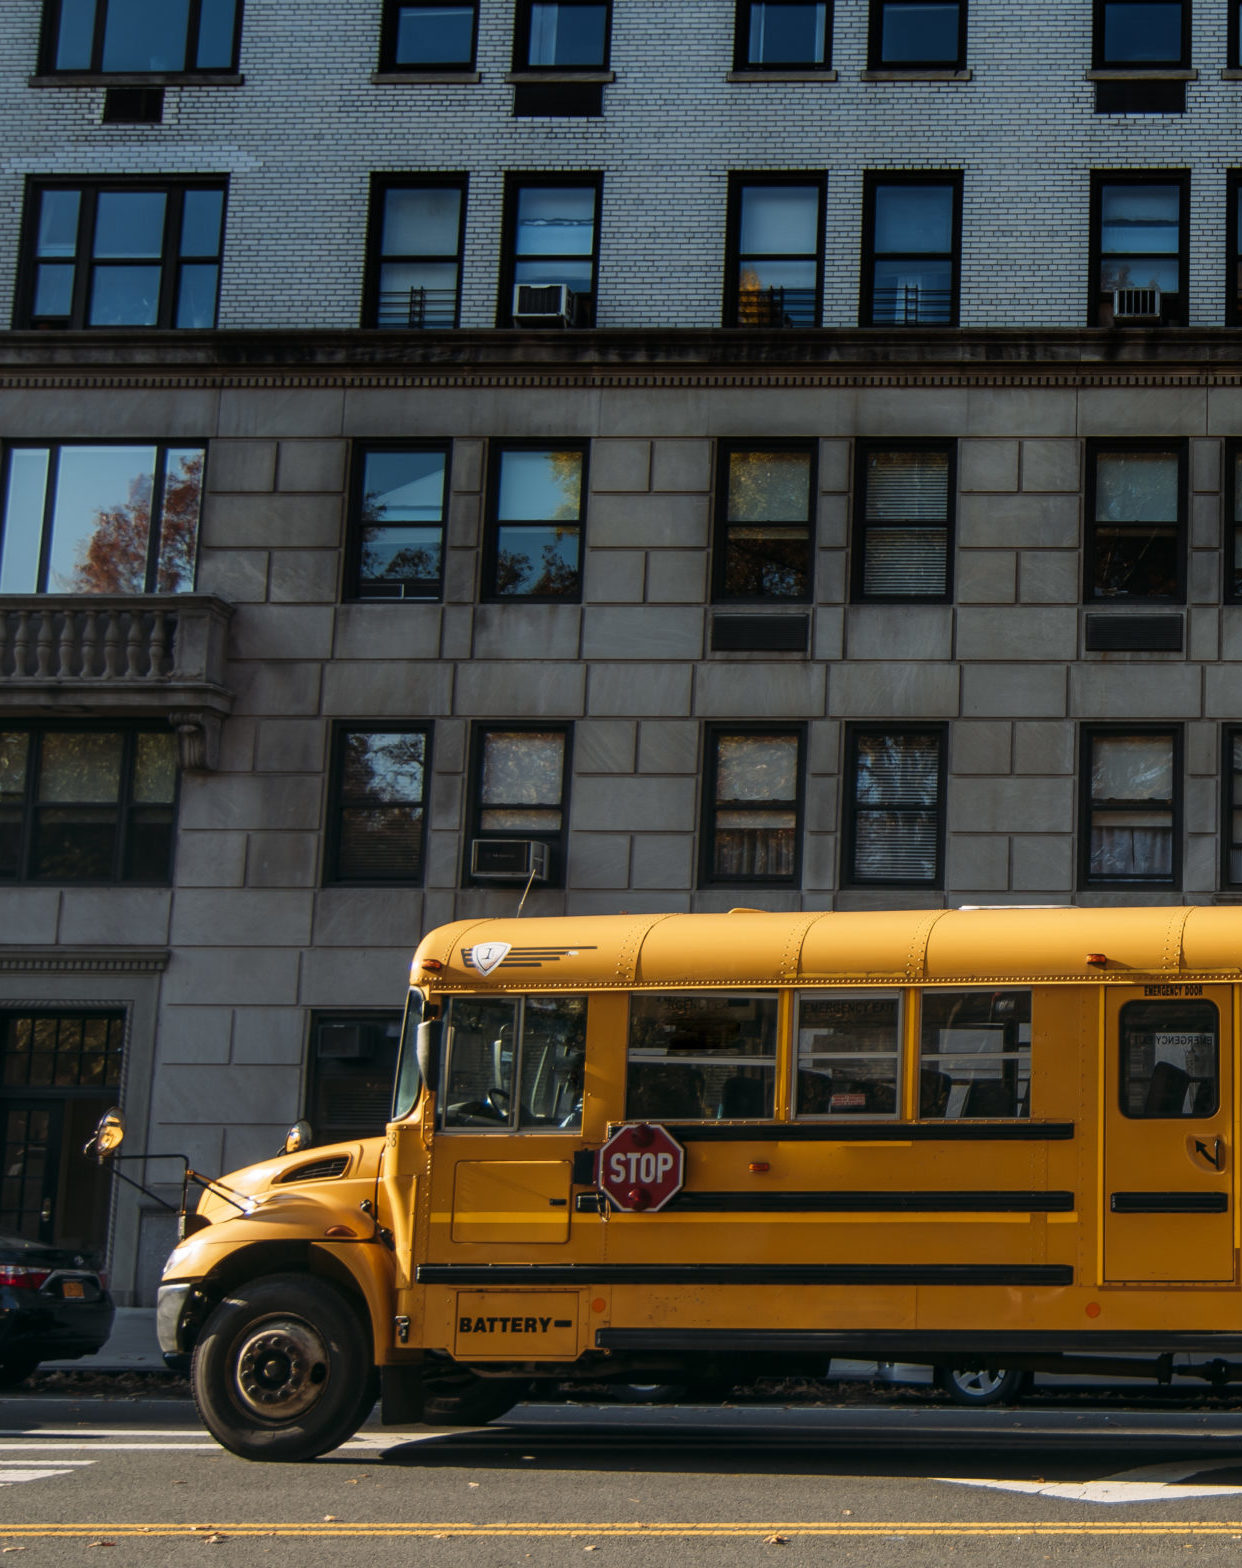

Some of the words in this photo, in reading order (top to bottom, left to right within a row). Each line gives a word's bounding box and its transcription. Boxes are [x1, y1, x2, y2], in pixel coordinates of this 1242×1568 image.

[1144, 984, 1183, 996] EMERGENCY
[1185, 984, 1203, 996] DOOR
[803, 1002, 871, 1014] EMERGENCY
[610, 1152, 674, 1184] STOP
[459, 1317, 552, 1333] BATTERY
